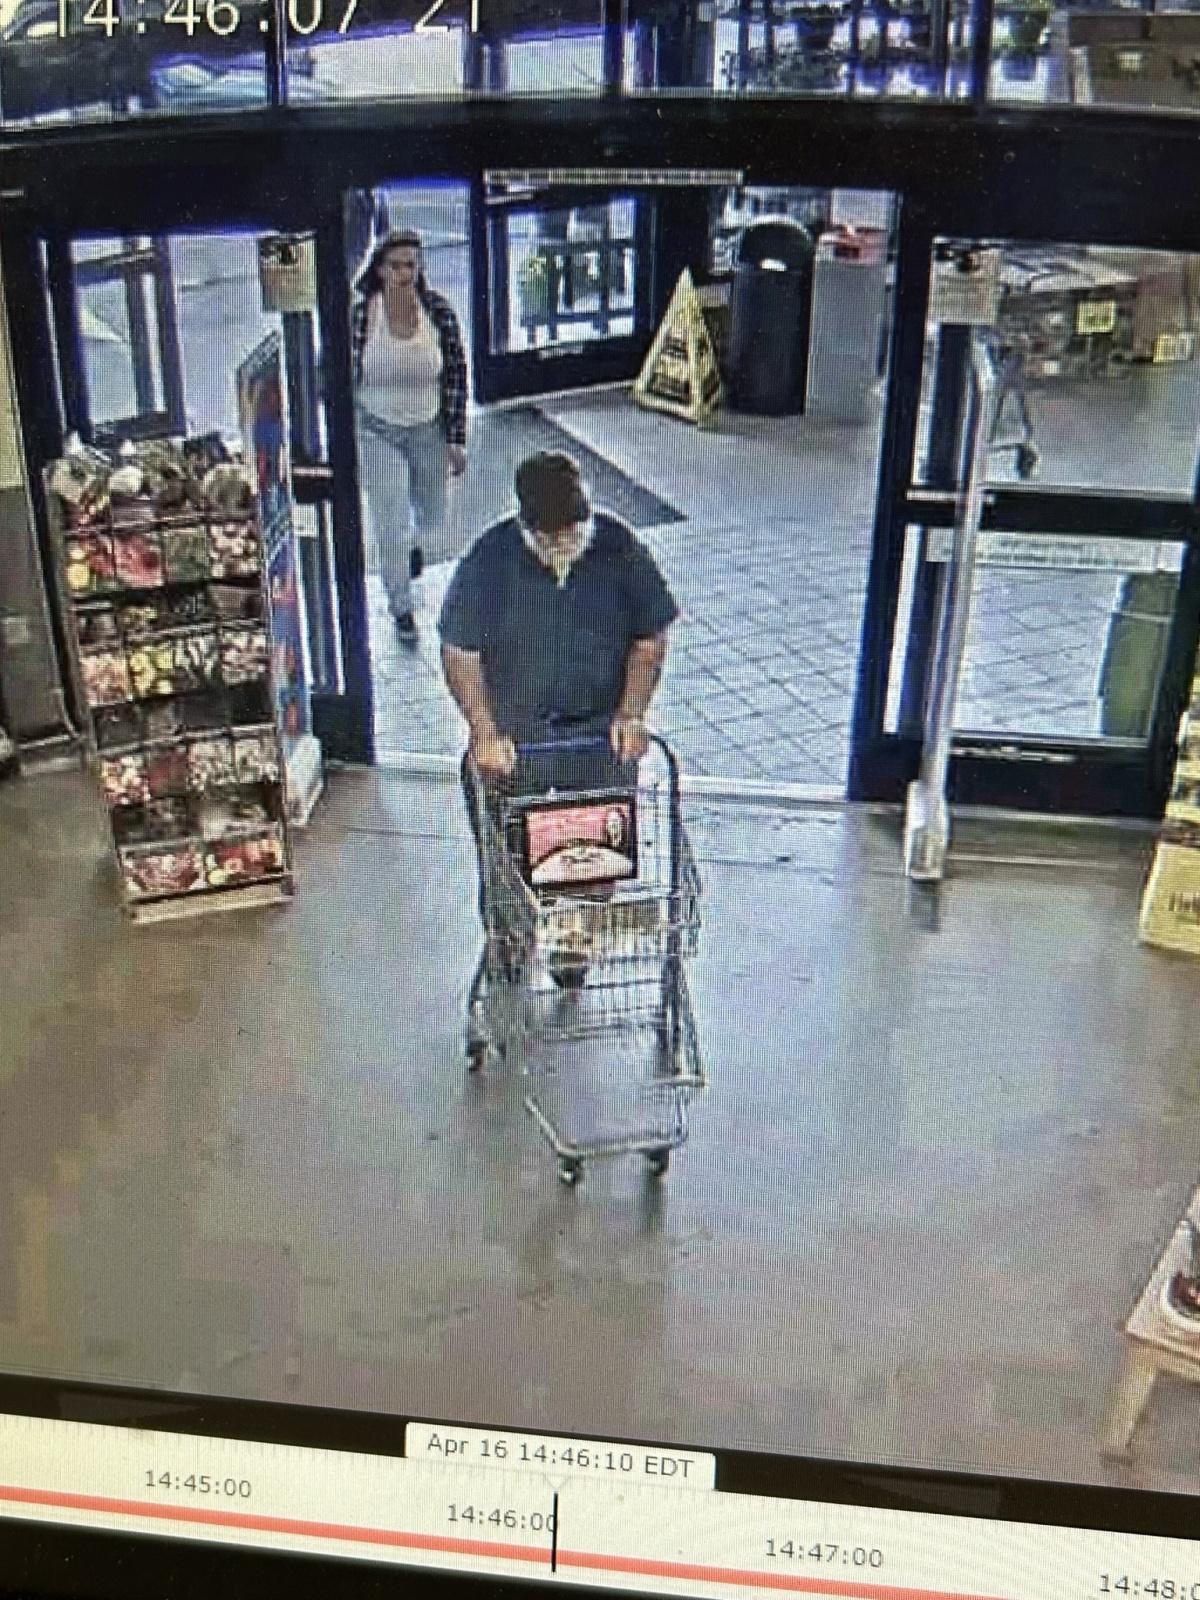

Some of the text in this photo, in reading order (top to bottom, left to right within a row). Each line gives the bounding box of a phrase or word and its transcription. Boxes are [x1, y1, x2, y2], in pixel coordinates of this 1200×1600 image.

[427, 1433, 695, 1478] Apr 16 14:46:10 EDT
[145, 1469, 252, 1498] 14:45:00
[765, 1538, 883, 1568] 14:47:00
